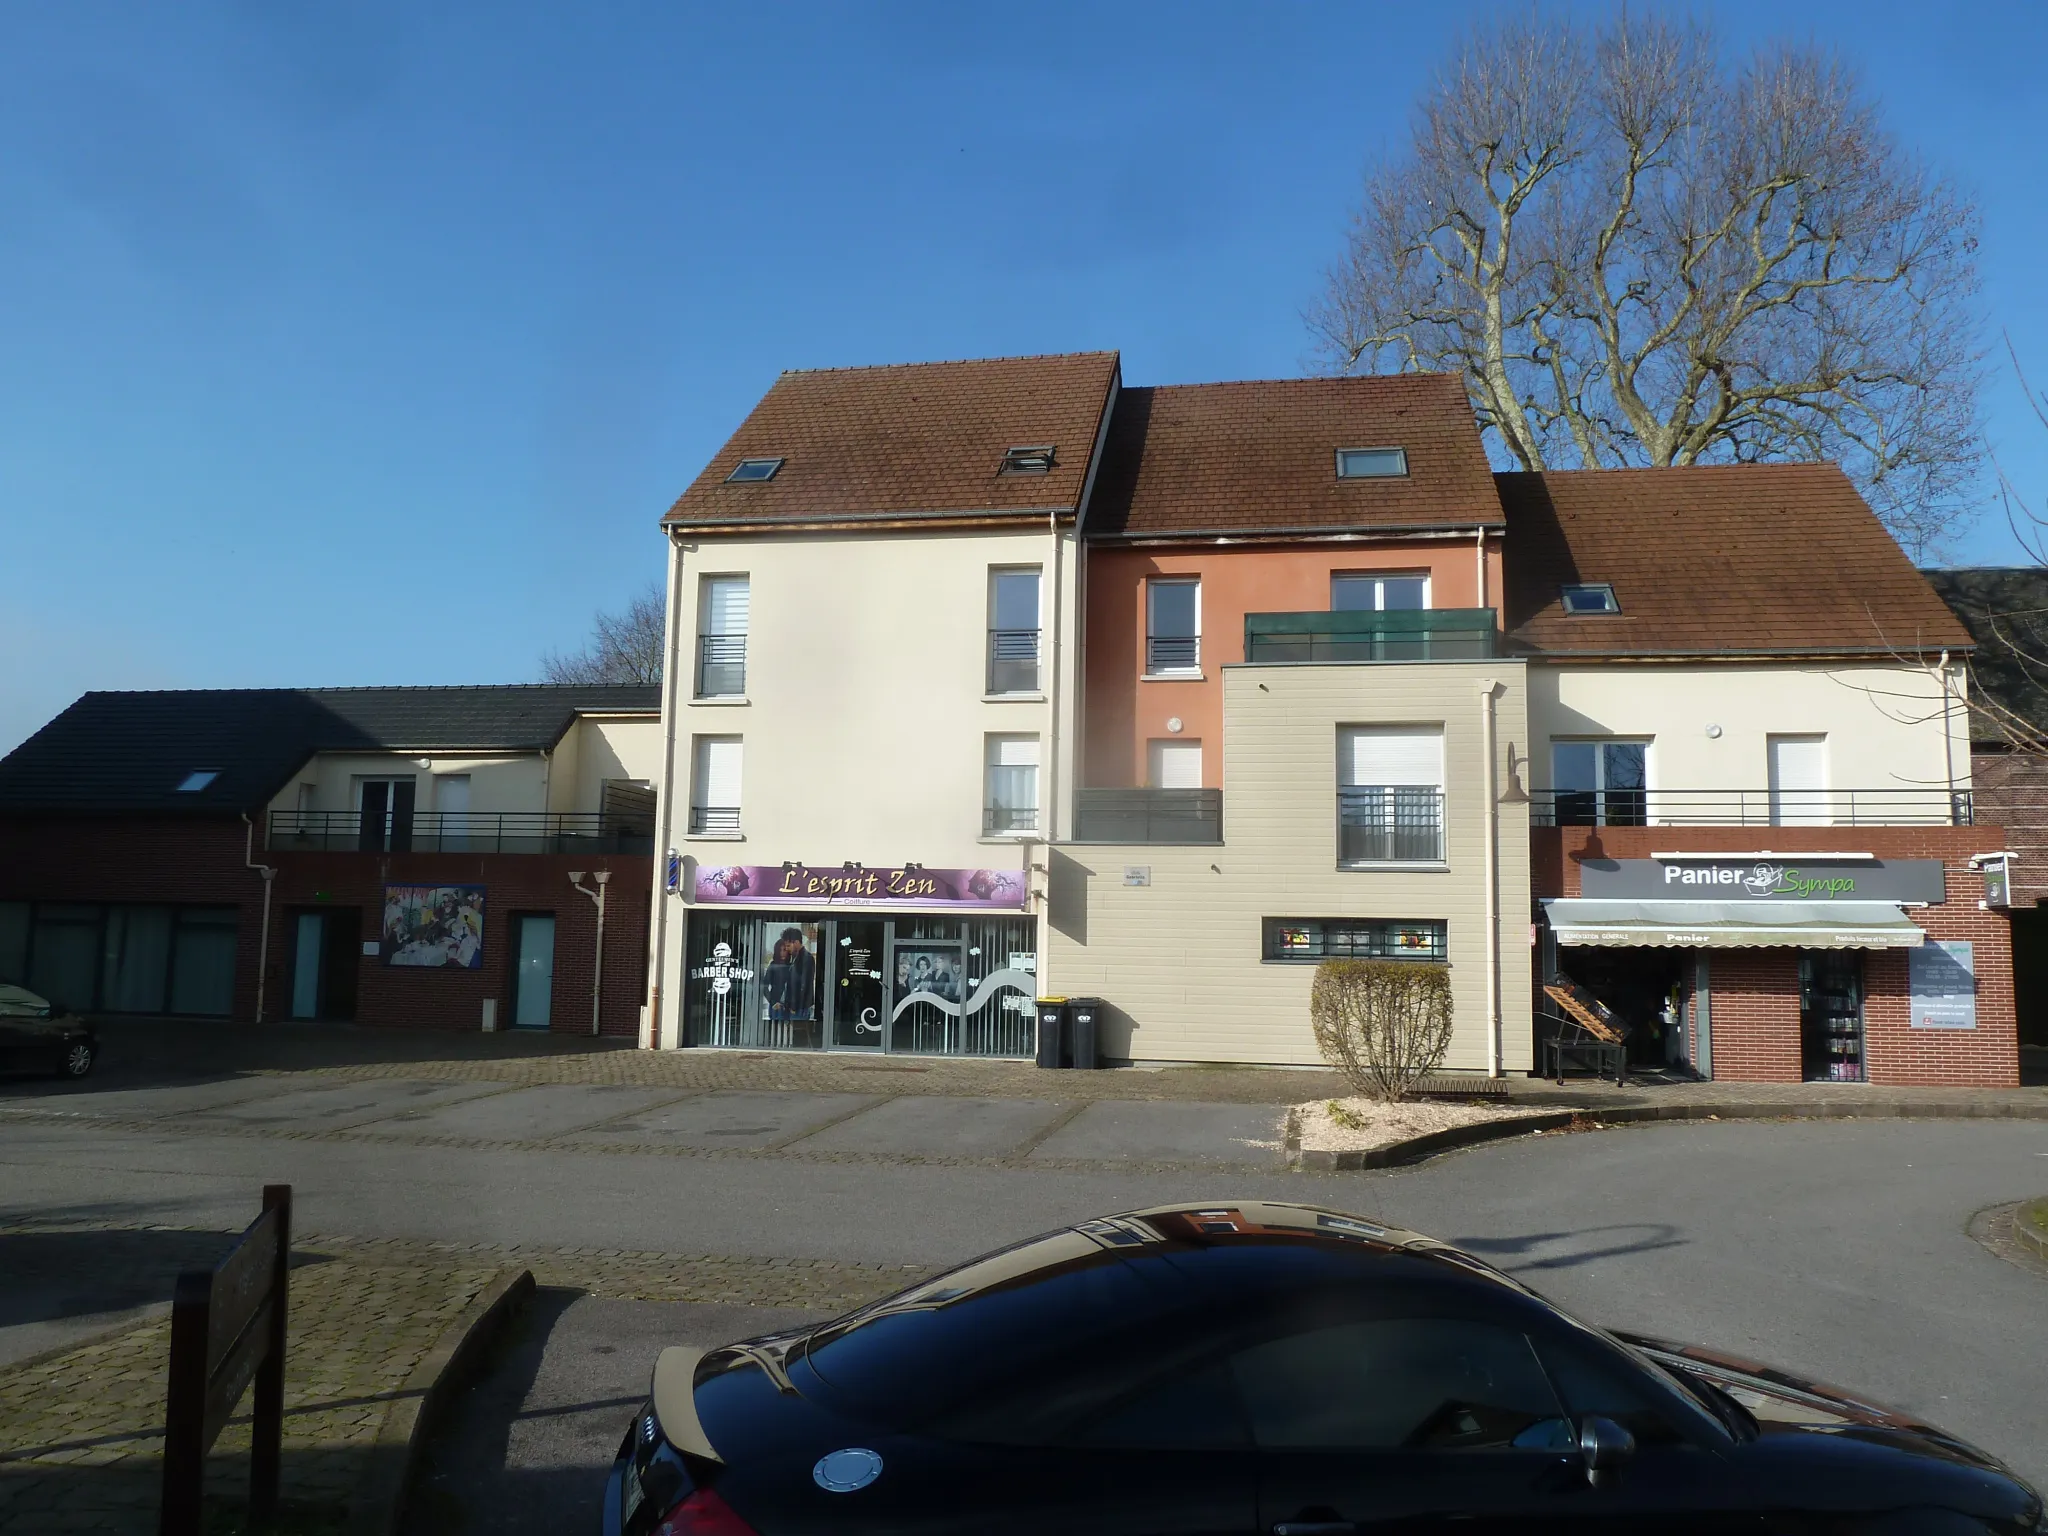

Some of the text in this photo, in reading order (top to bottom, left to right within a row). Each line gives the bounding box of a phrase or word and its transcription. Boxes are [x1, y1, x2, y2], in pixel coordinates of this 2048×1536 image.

[778, 870, 937, 904] L'esprit Zen
[1664, 865, 1855, 899] Panier Sympa
[1666, 933, 1710, 942] Panier
[691, 966, 754, 981] BARBER SHOP
